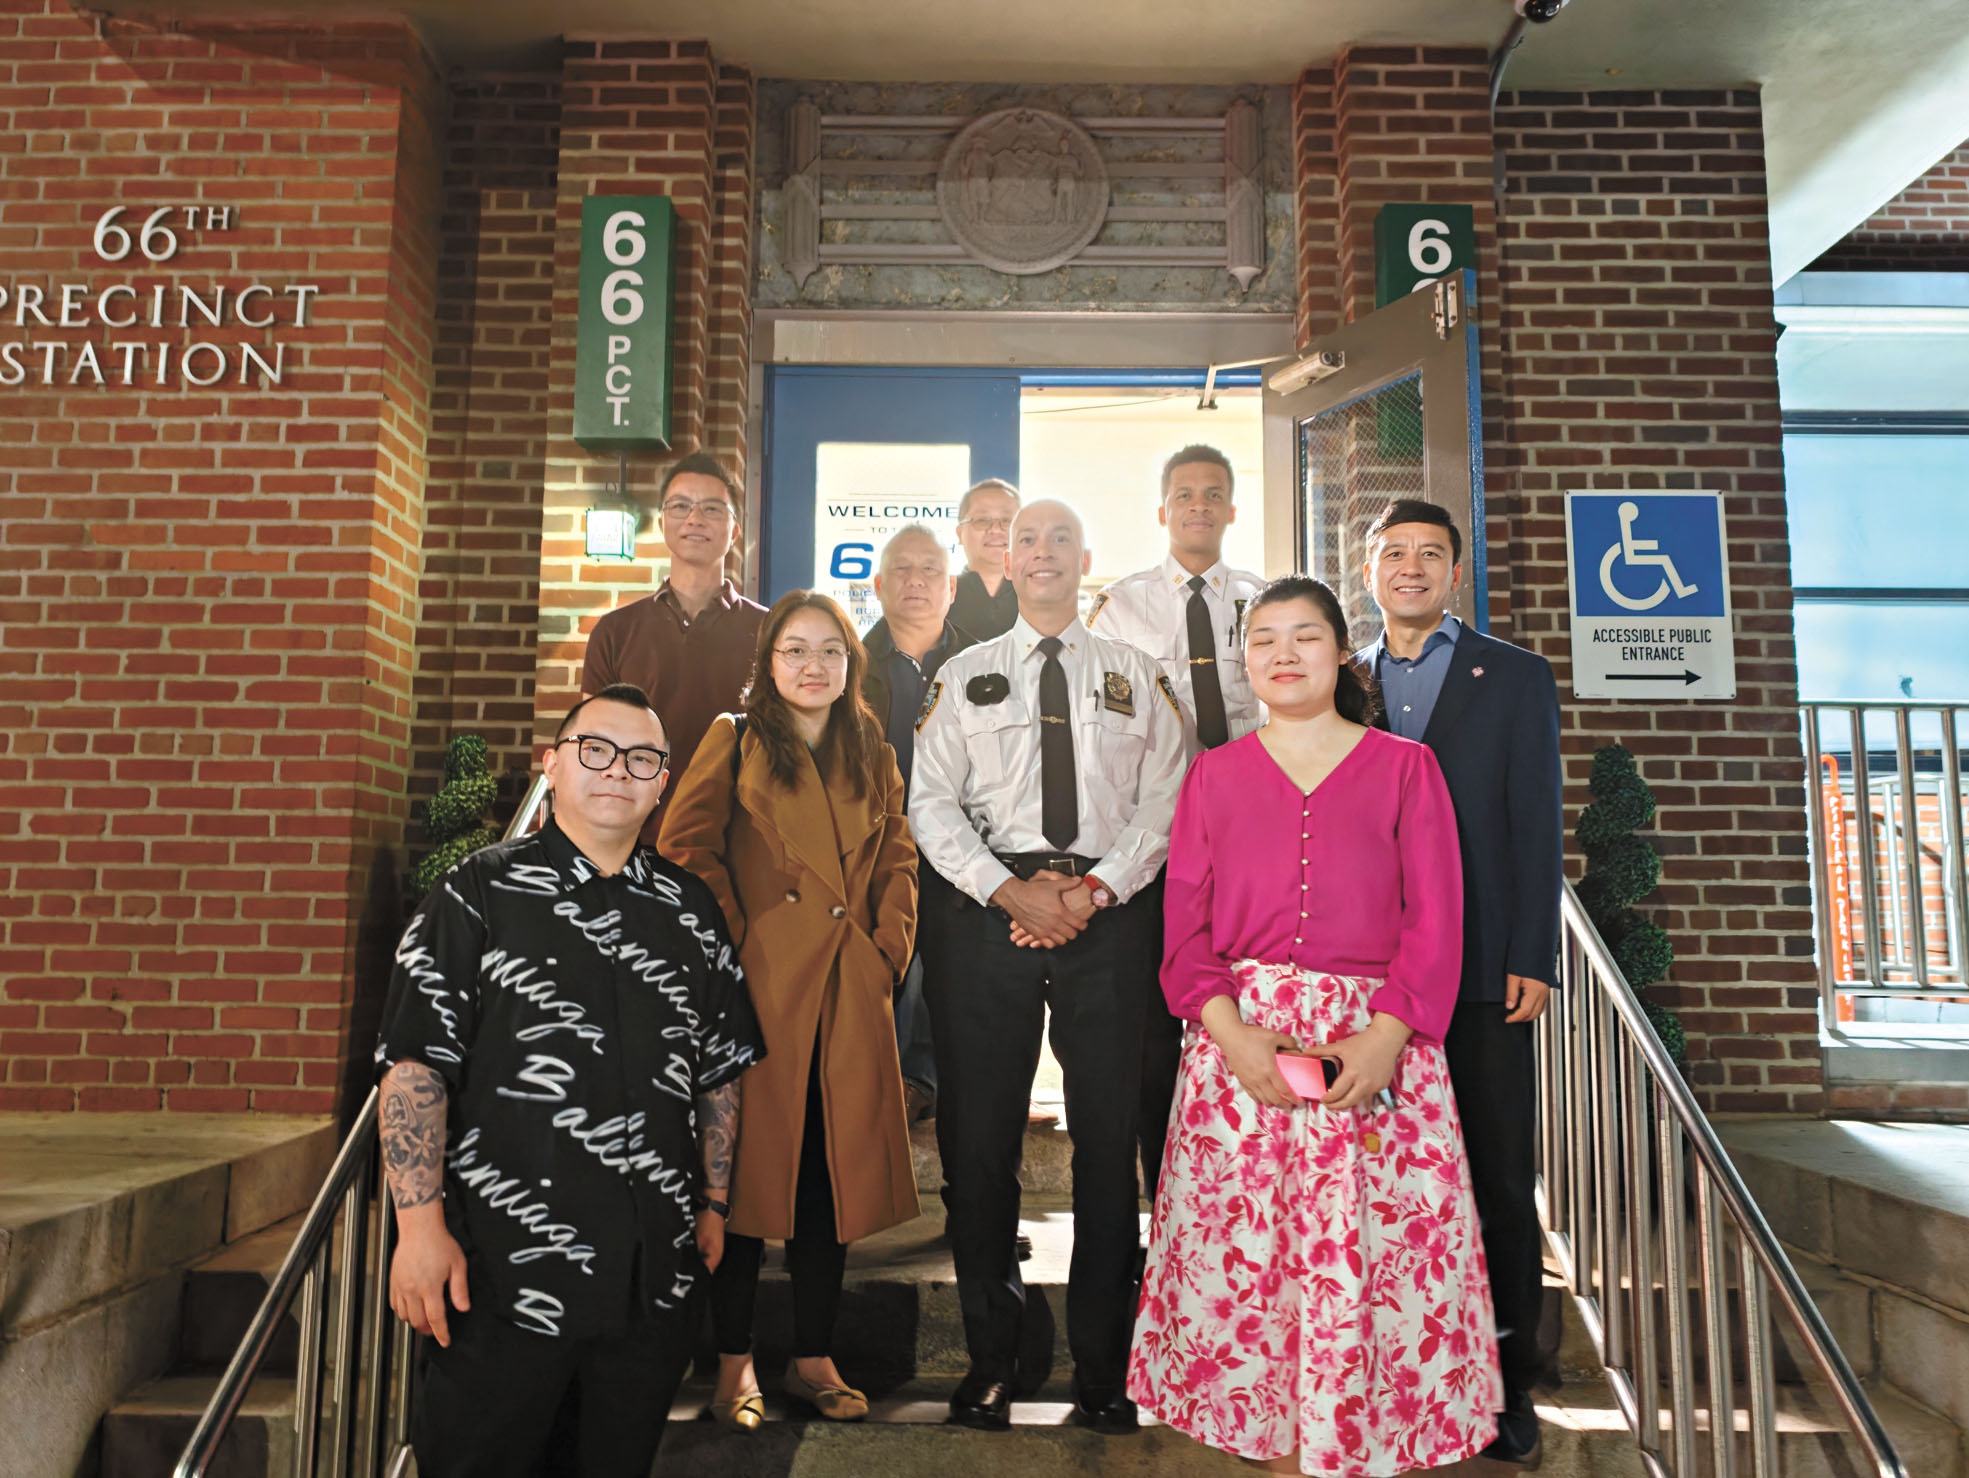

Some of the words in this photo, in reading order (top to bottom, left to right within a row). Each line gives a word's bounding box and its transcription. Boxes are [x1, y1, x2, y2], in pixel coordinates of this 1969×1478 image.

[93, 206, 230, 261] 66TH
[600, 210, 647, 325] 66
[1408, 219, 1453, 293] 6
[0, 284, 319, 328] RECINCT
[0, 341, 285, 385] STATION
[604, 335, 632, 426] PCT.
[828, 505, 959, 518] WELCOME
[1593, 629, 1665, 643] ACCESSIBLE
[1669, 629, 1712, 643] PUBLIC
[1622, 646, 1685, 661] ENTRANCE
